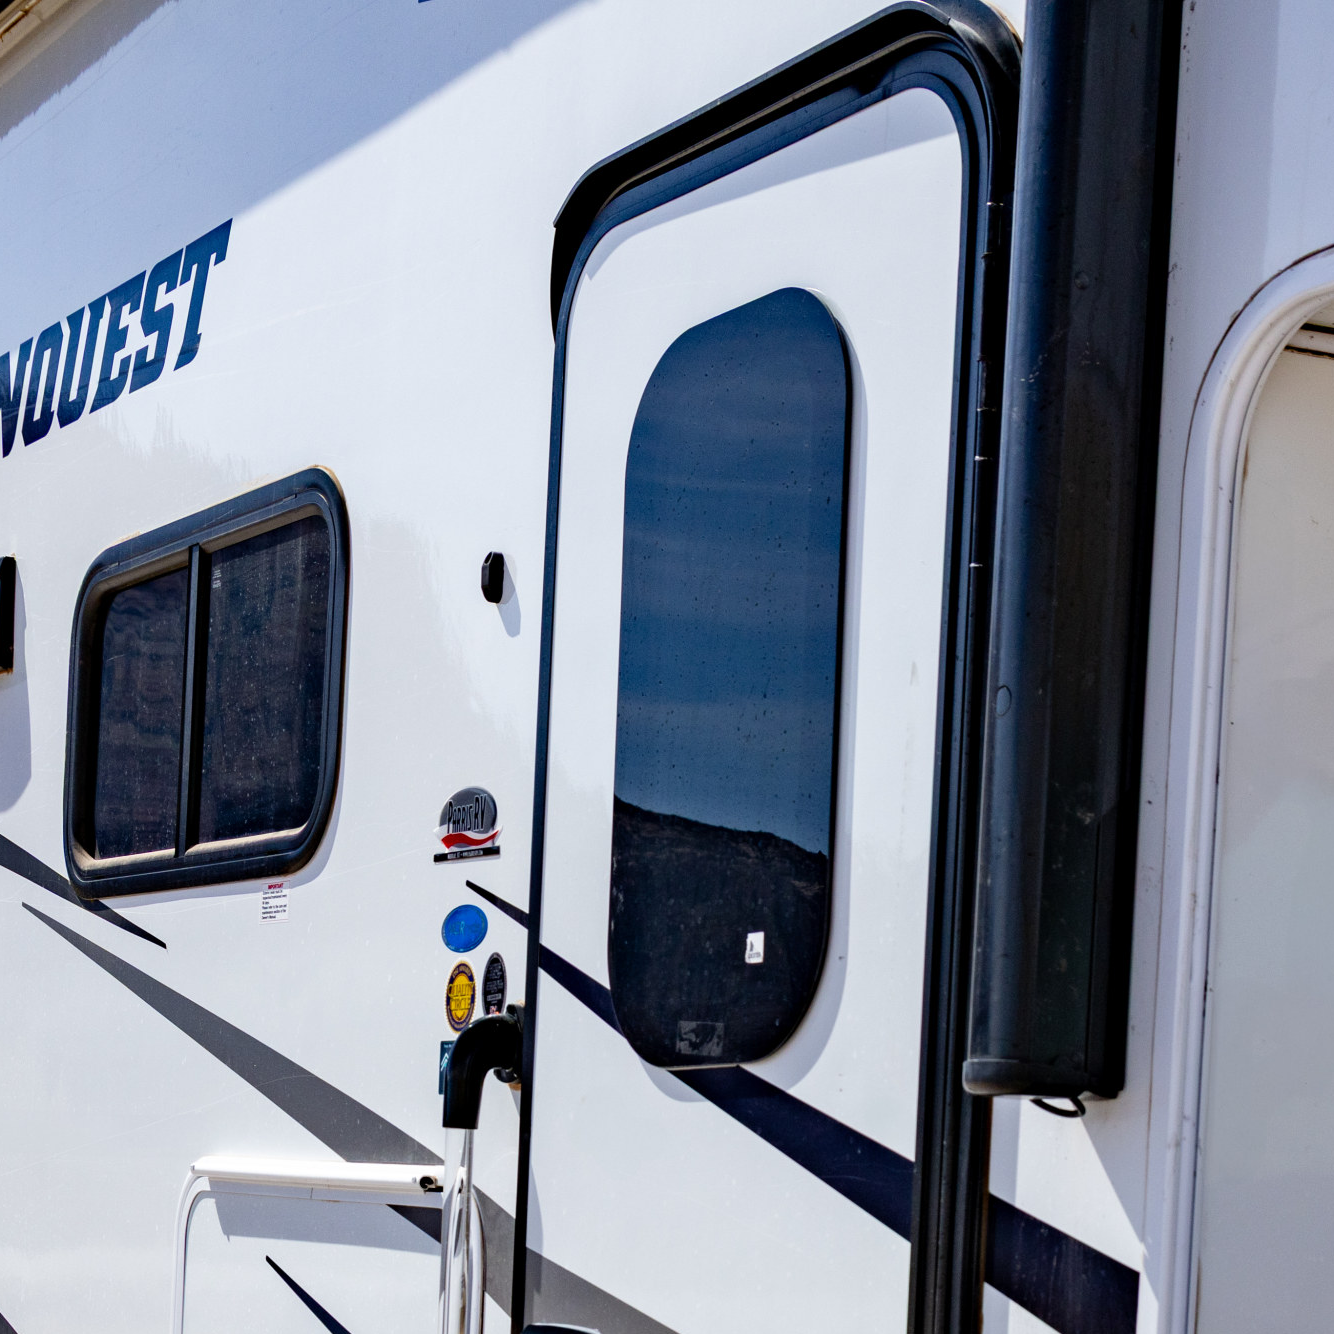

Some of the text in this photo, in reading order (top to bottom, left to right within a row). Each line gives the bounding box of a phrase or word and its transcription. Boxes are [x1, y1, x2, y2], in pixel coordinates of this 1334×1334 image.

[447, 793, 488, 834] PARRIS RV
[448, 982, 475, 997] QUALITY
[450, 996, 472, 1011] CIRCLE
